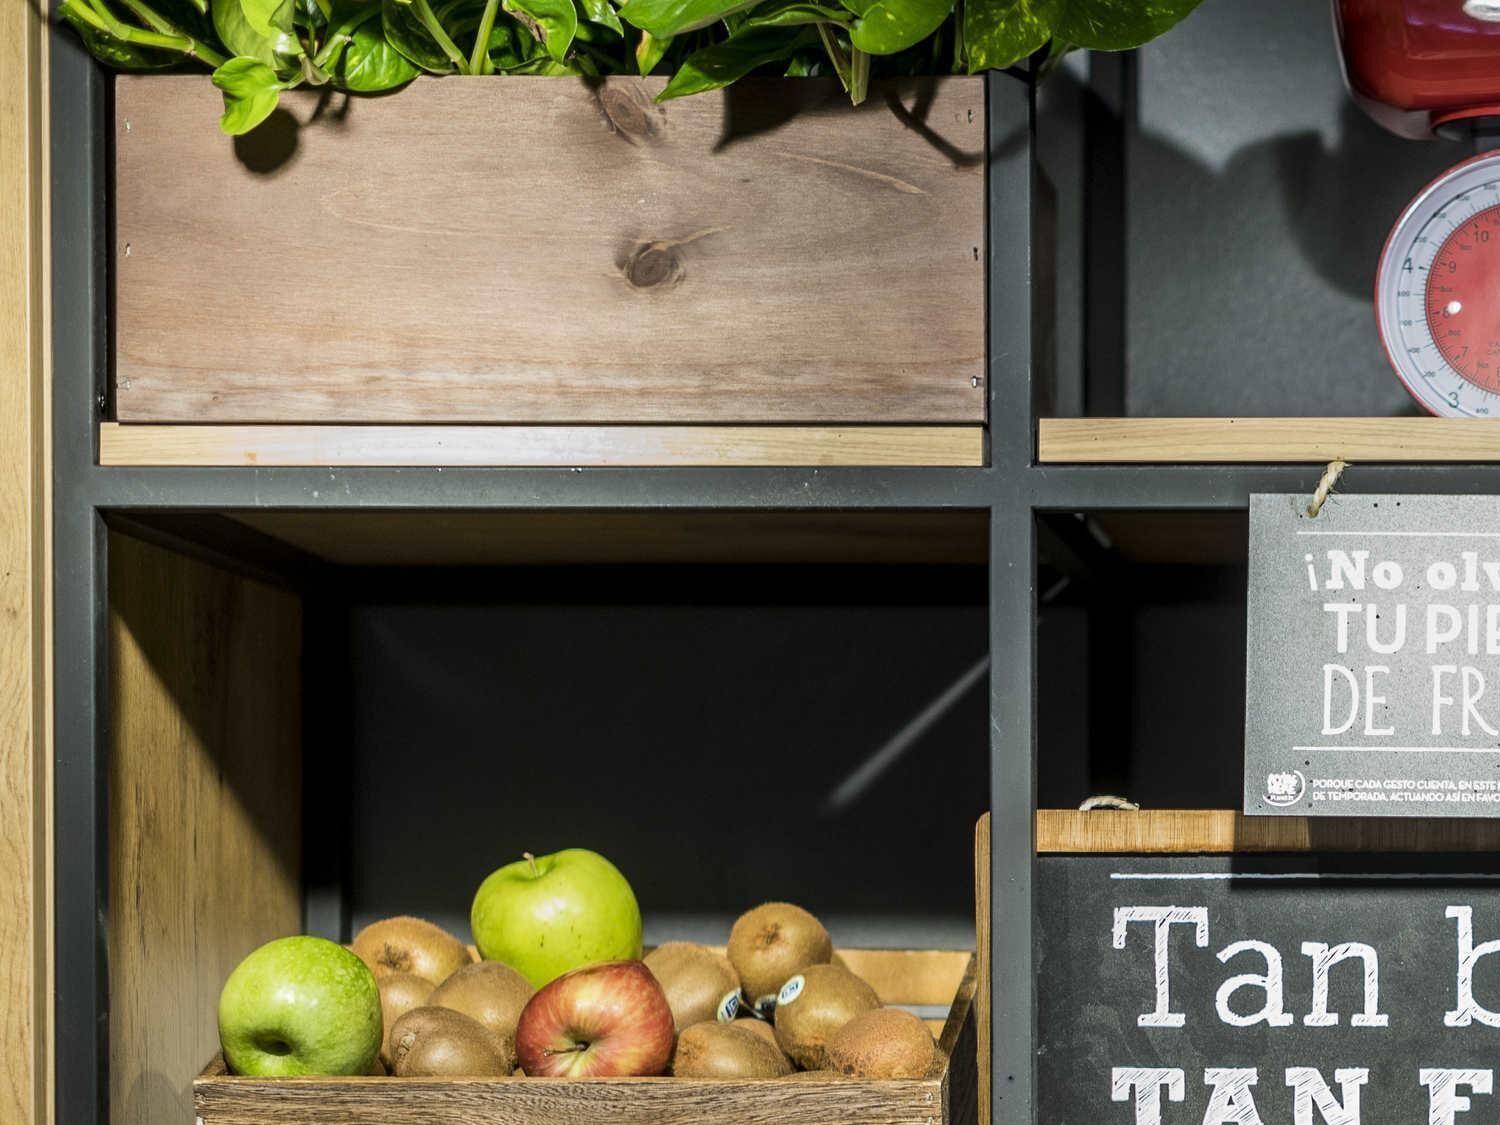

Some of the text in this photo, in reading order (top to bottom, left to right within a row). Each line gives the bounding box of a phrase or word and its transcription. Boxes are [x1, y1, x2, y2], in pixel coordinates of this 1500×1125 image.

[1474, 231, 1489, 242] 10
[1402, 257, 1413, 274] 4
[1448, 261, 1457, 273] 9
[1461, 346, 1469, 357] 7
[1447, 391, 1460, 409] 3
[1304, 550, 1403, 592] ¡No
[1323, 602, 1407, 654] TU
[1320, 663, 1395, 735] DE
[1312, 779, 1354, 790] PORQUE
[1355, 780, 1383, 789] CADA
[1383, 780, 1416, 790] GESTO
[1458, 780, 1473, 790] EN
[1473, 781, 1497, 791] ESTE
[1312, 791, 1327, 801] DE
[1390, 792, 1445, 802] ACTUANDO
[1461, 792, 1476, 802] EN
[1112, 905, 1390, 1027] Tan
